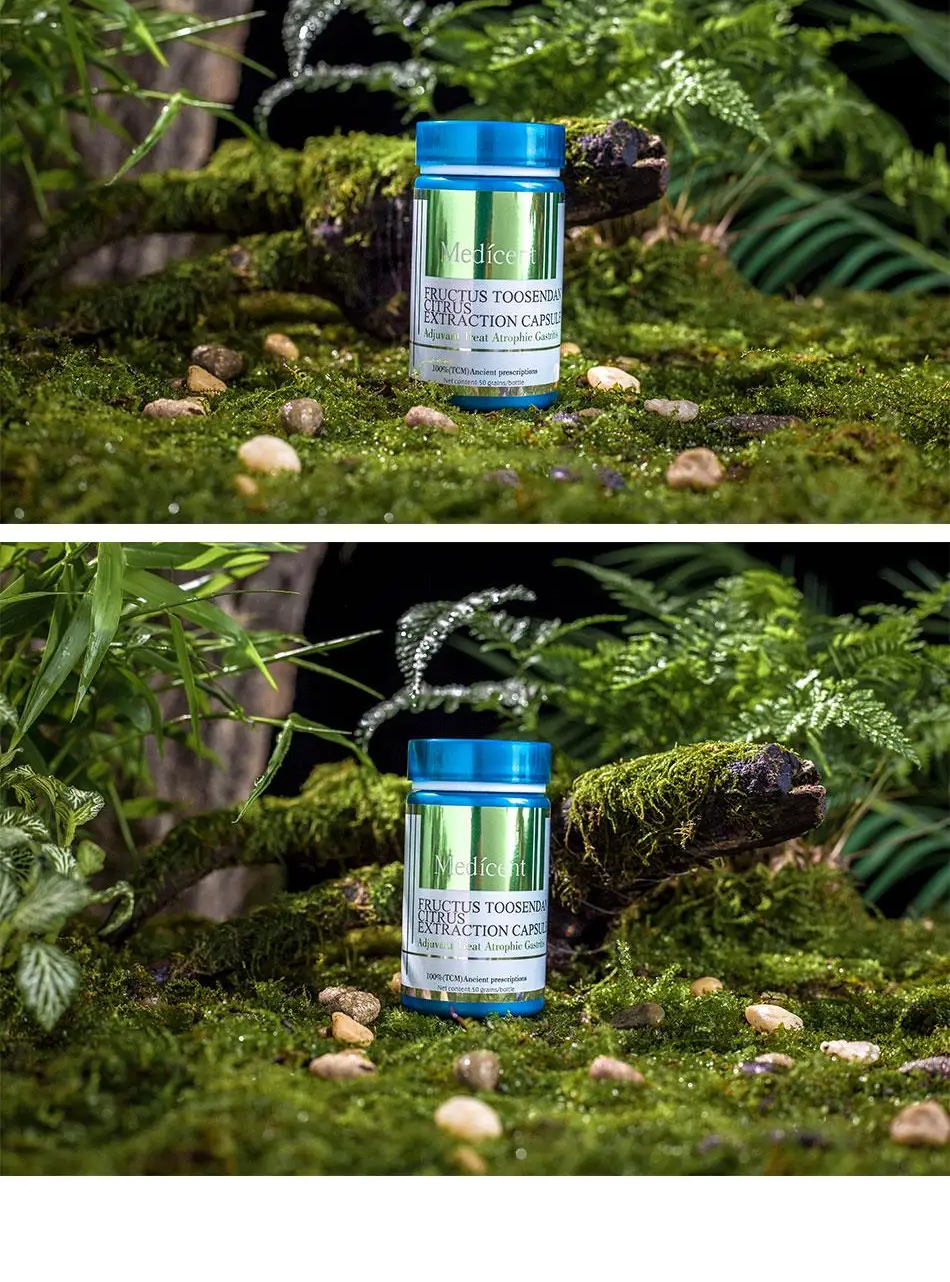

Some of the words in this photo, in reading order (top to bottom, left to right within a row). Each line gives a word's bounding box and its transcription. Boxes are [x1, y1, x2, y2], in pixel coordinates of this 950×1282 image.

[424, 286, 488, 303] FRUCTUS
[424, 299, 472, 314] CITRUS
[424, 310, 518, 328] EXTRACTION
[491, 332, 533, 345] Atrophic
[498, 367, 538, 378] prescriptions
[418, 898, 481, 914] FRUCTUS
[418, 910, 466, 925] CITRUS
[418, 921, 509, 937] EXTRACTION
[485, 941, 523, 954] Atrophic
[490, 974, 528, 984] prescriptions
